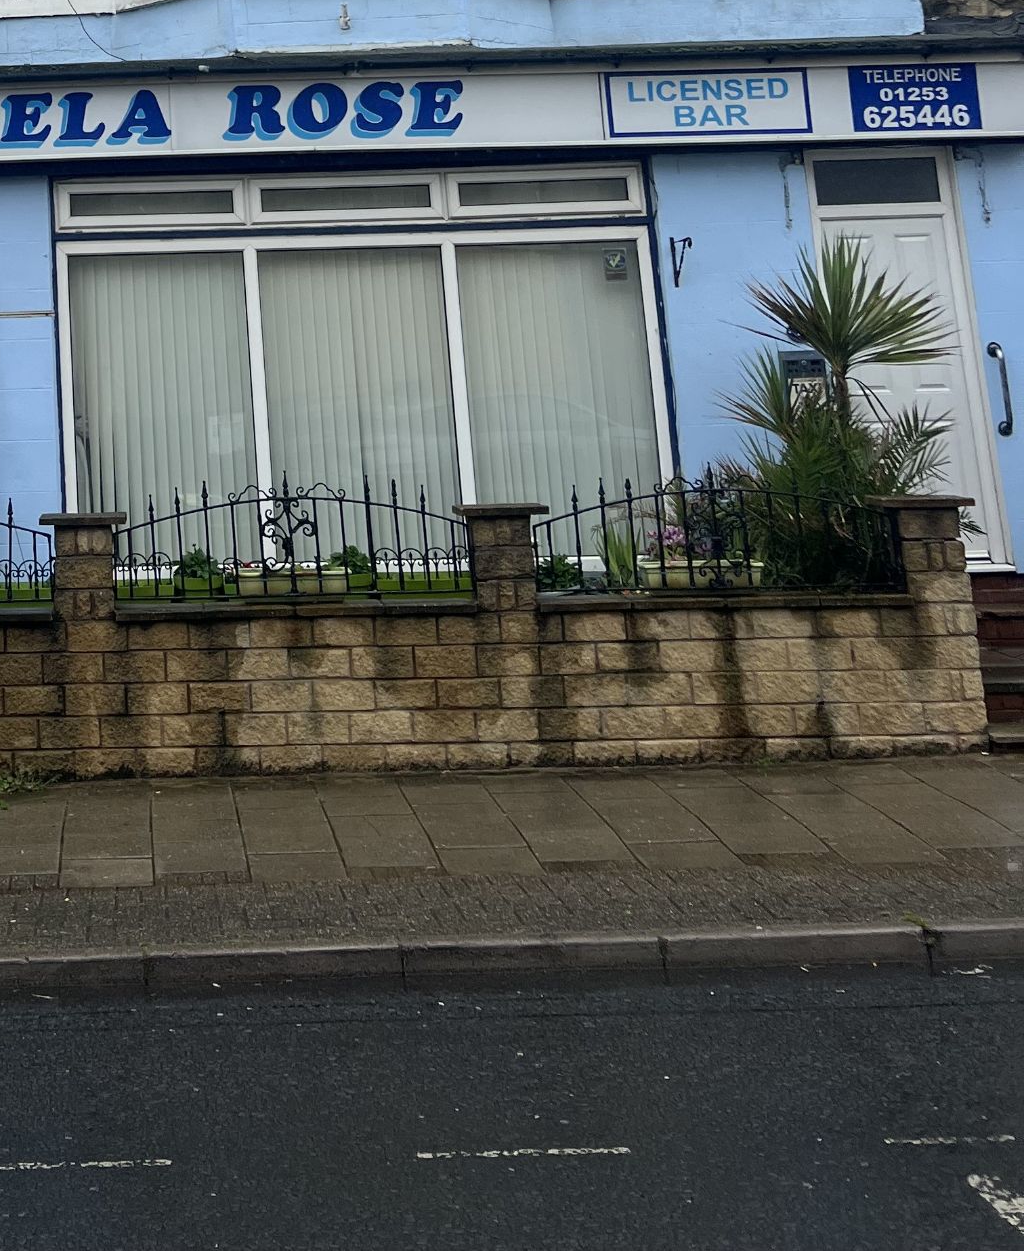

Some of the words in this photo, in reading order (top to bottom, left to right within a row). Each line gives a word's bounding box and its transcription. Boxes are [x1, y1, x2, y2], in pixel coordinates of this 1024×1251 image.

[862, 67, 962, 84] TELEPHONE
[627, 77, 789, 102] LICENSED
[879, 86, 948, 101] 01253
[222, 79, 464, 142] ROSE
[673, 105, 749, 127] BAR
[862, 104, 970, 128] 625446
